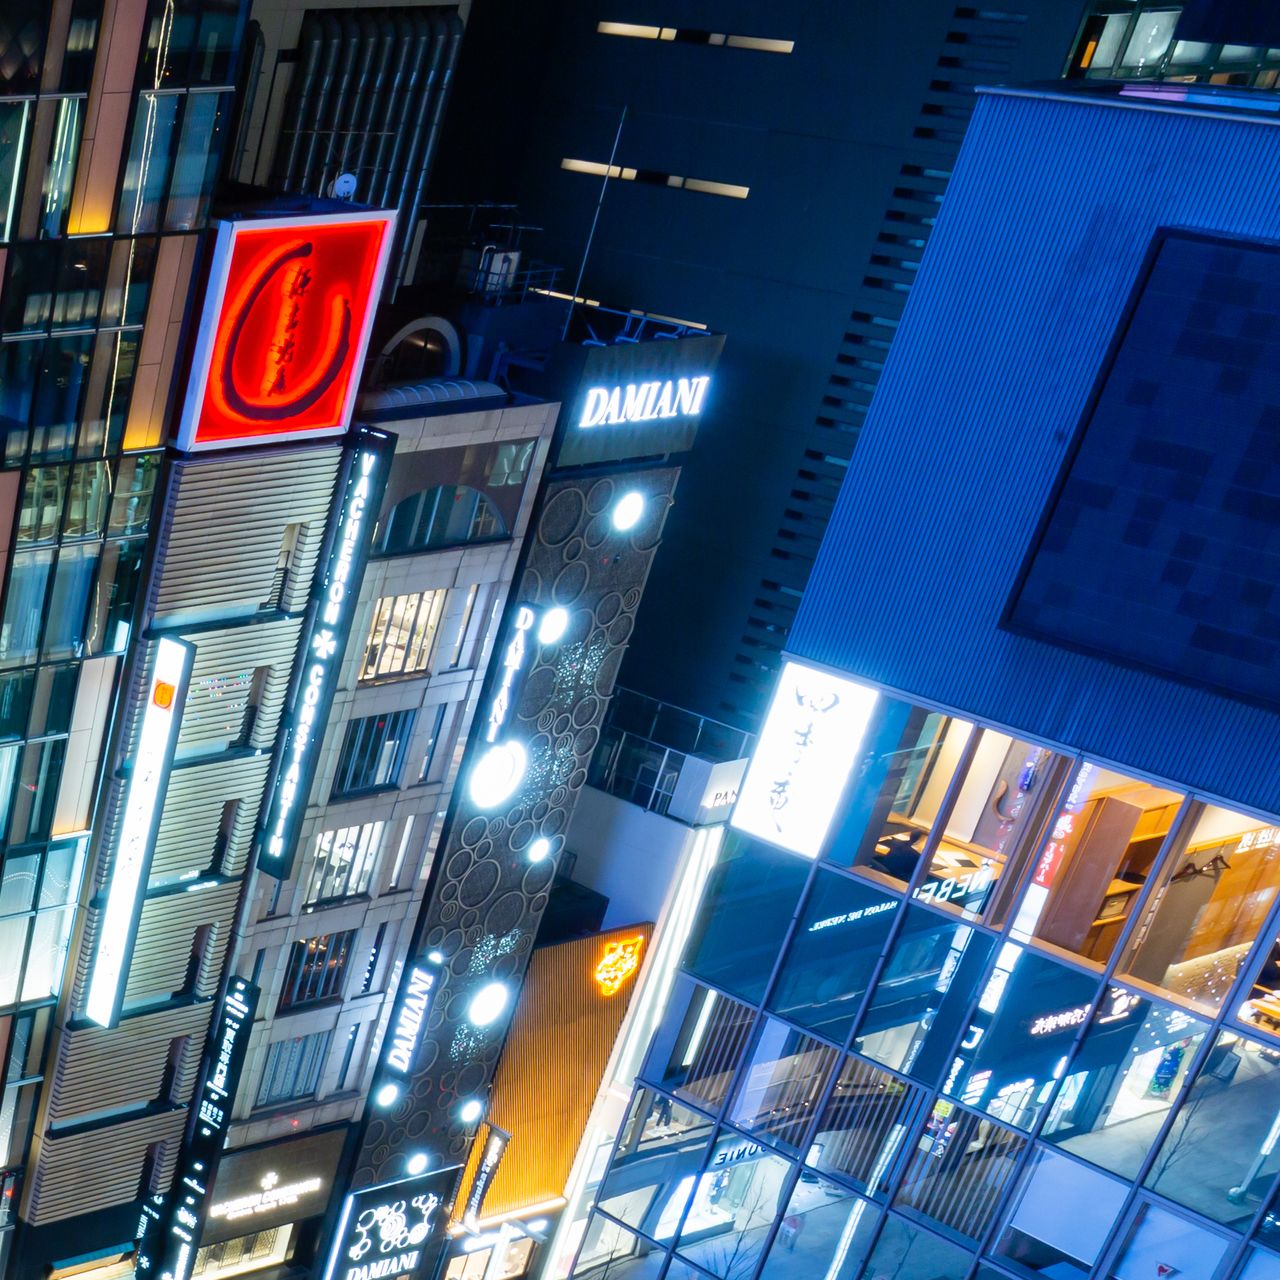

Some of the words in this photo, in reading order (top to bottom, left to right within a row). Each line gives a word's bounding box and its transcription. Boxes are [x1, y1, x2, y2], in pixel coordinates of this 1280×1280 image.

[579, 376, 710, 428] DAMIANI
[323, 453, 375, 625] VACHERON
[486, 607, 534, 742] DAMIANI
[269, 664, 324, 858] CONSTANTIN
[388, 968, 433, 1072] DAMIANI
